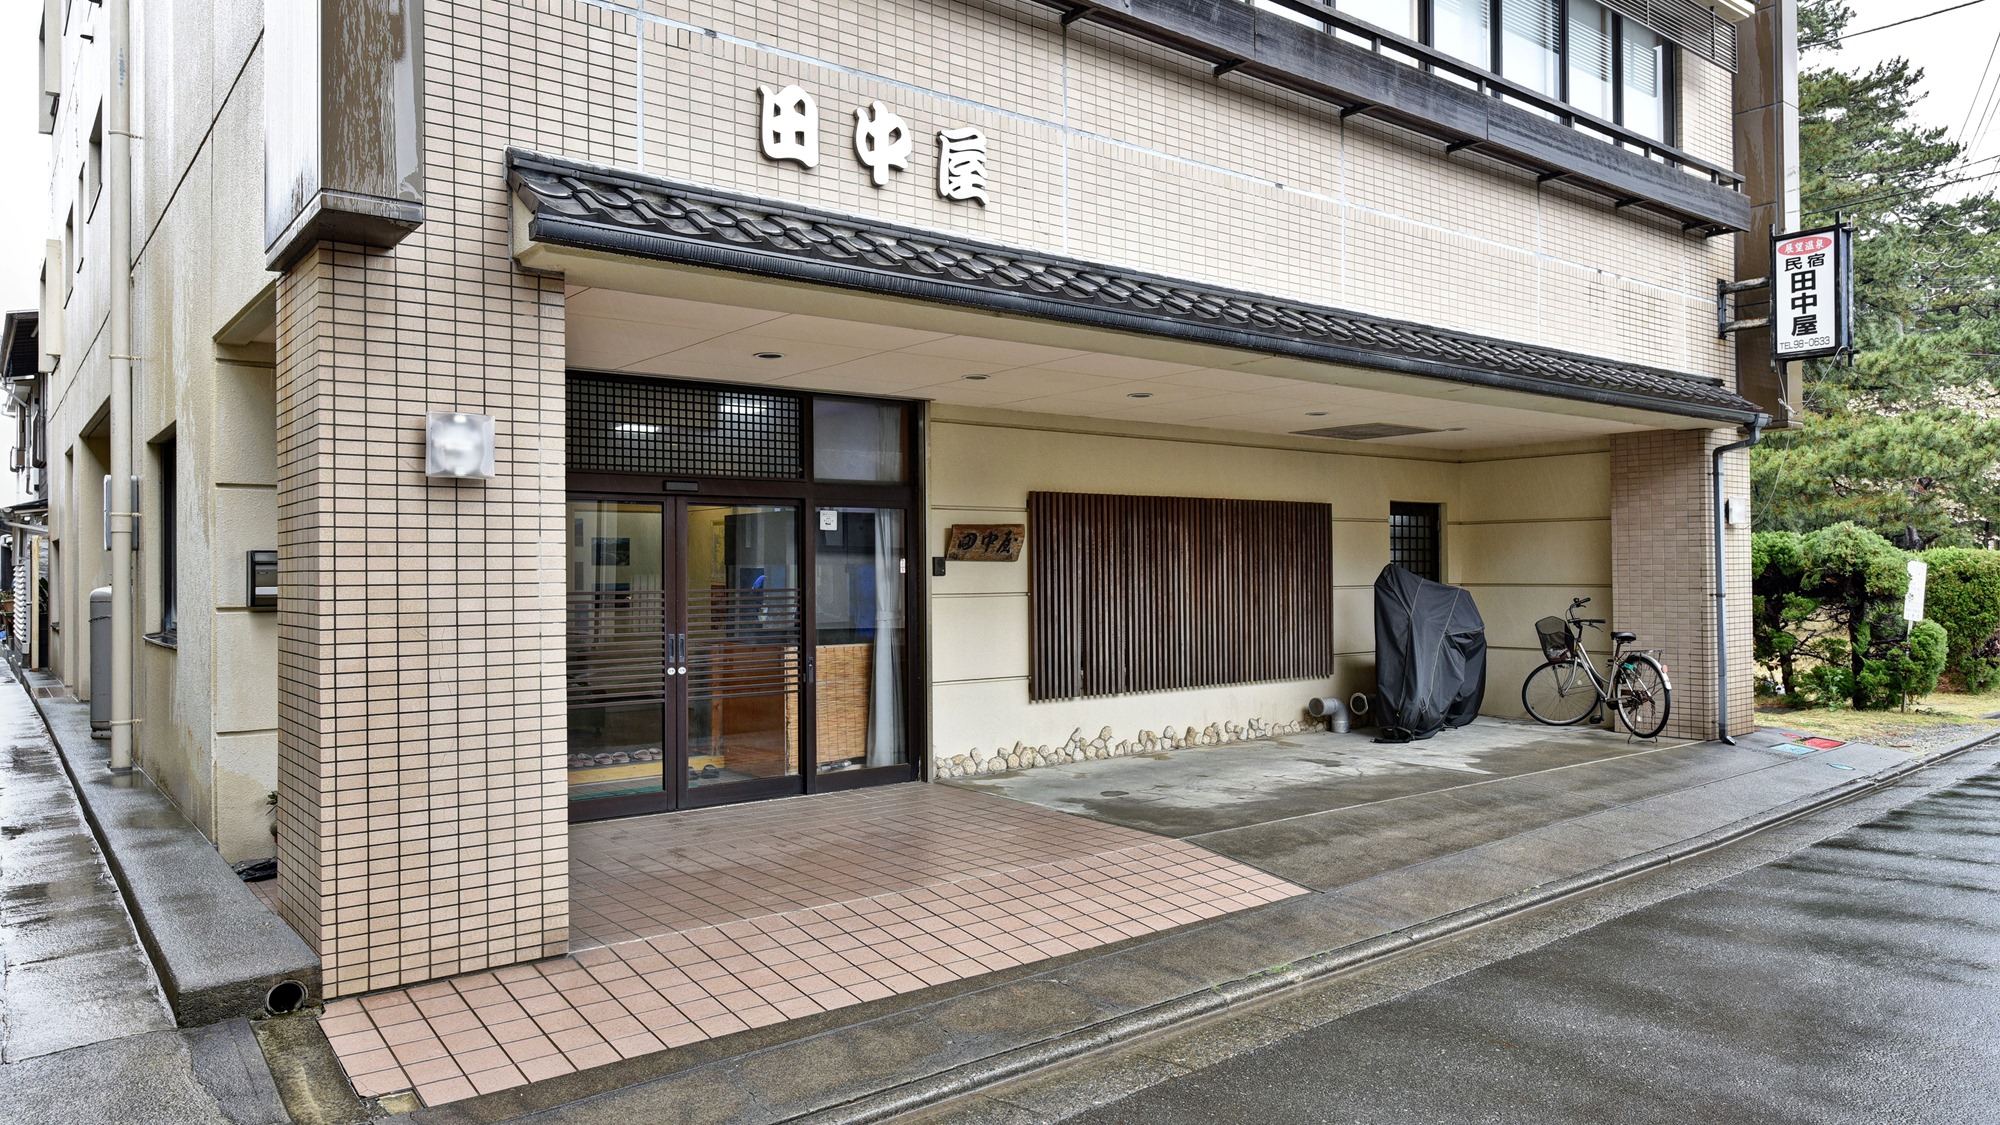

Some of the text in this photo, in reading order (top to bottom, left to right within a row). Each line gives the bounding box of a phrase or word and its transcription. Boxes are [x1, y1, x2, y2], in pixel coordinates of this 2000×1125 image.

[758, 85, 990, 206] 田中屋
[1785, 253, 1825, 272] 民宿
[1791, 270, 1818, 337] 田中屋
[957, 530, 1018, 553] 田中屋
